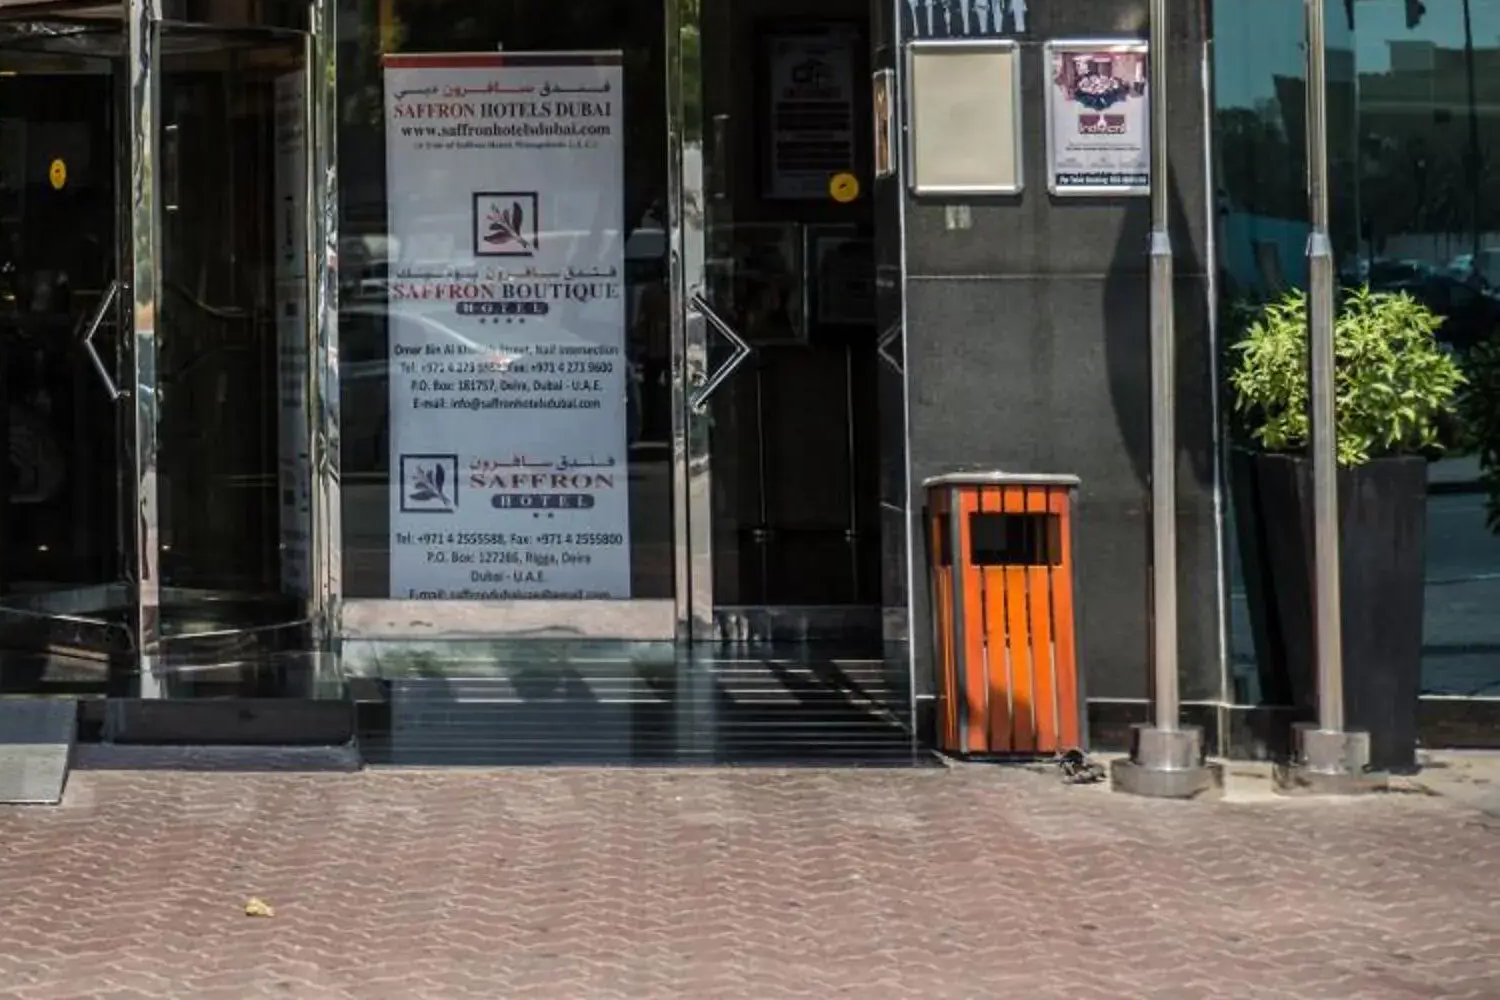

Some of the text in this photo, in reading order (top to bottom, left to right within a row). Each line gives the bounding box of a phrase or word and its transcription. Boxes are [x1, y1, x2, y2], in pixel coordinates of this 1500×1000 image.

[394, 101, 611, 119] SAFFRON HOTELS DUBAI
[392, 282, 620, 302] SAFFRON BOUTIQUE
[469, 473, 615, 489] SAFFRON
[501, 495, 589, 507] HOTEL
[416, 533, 444, 545] +971
